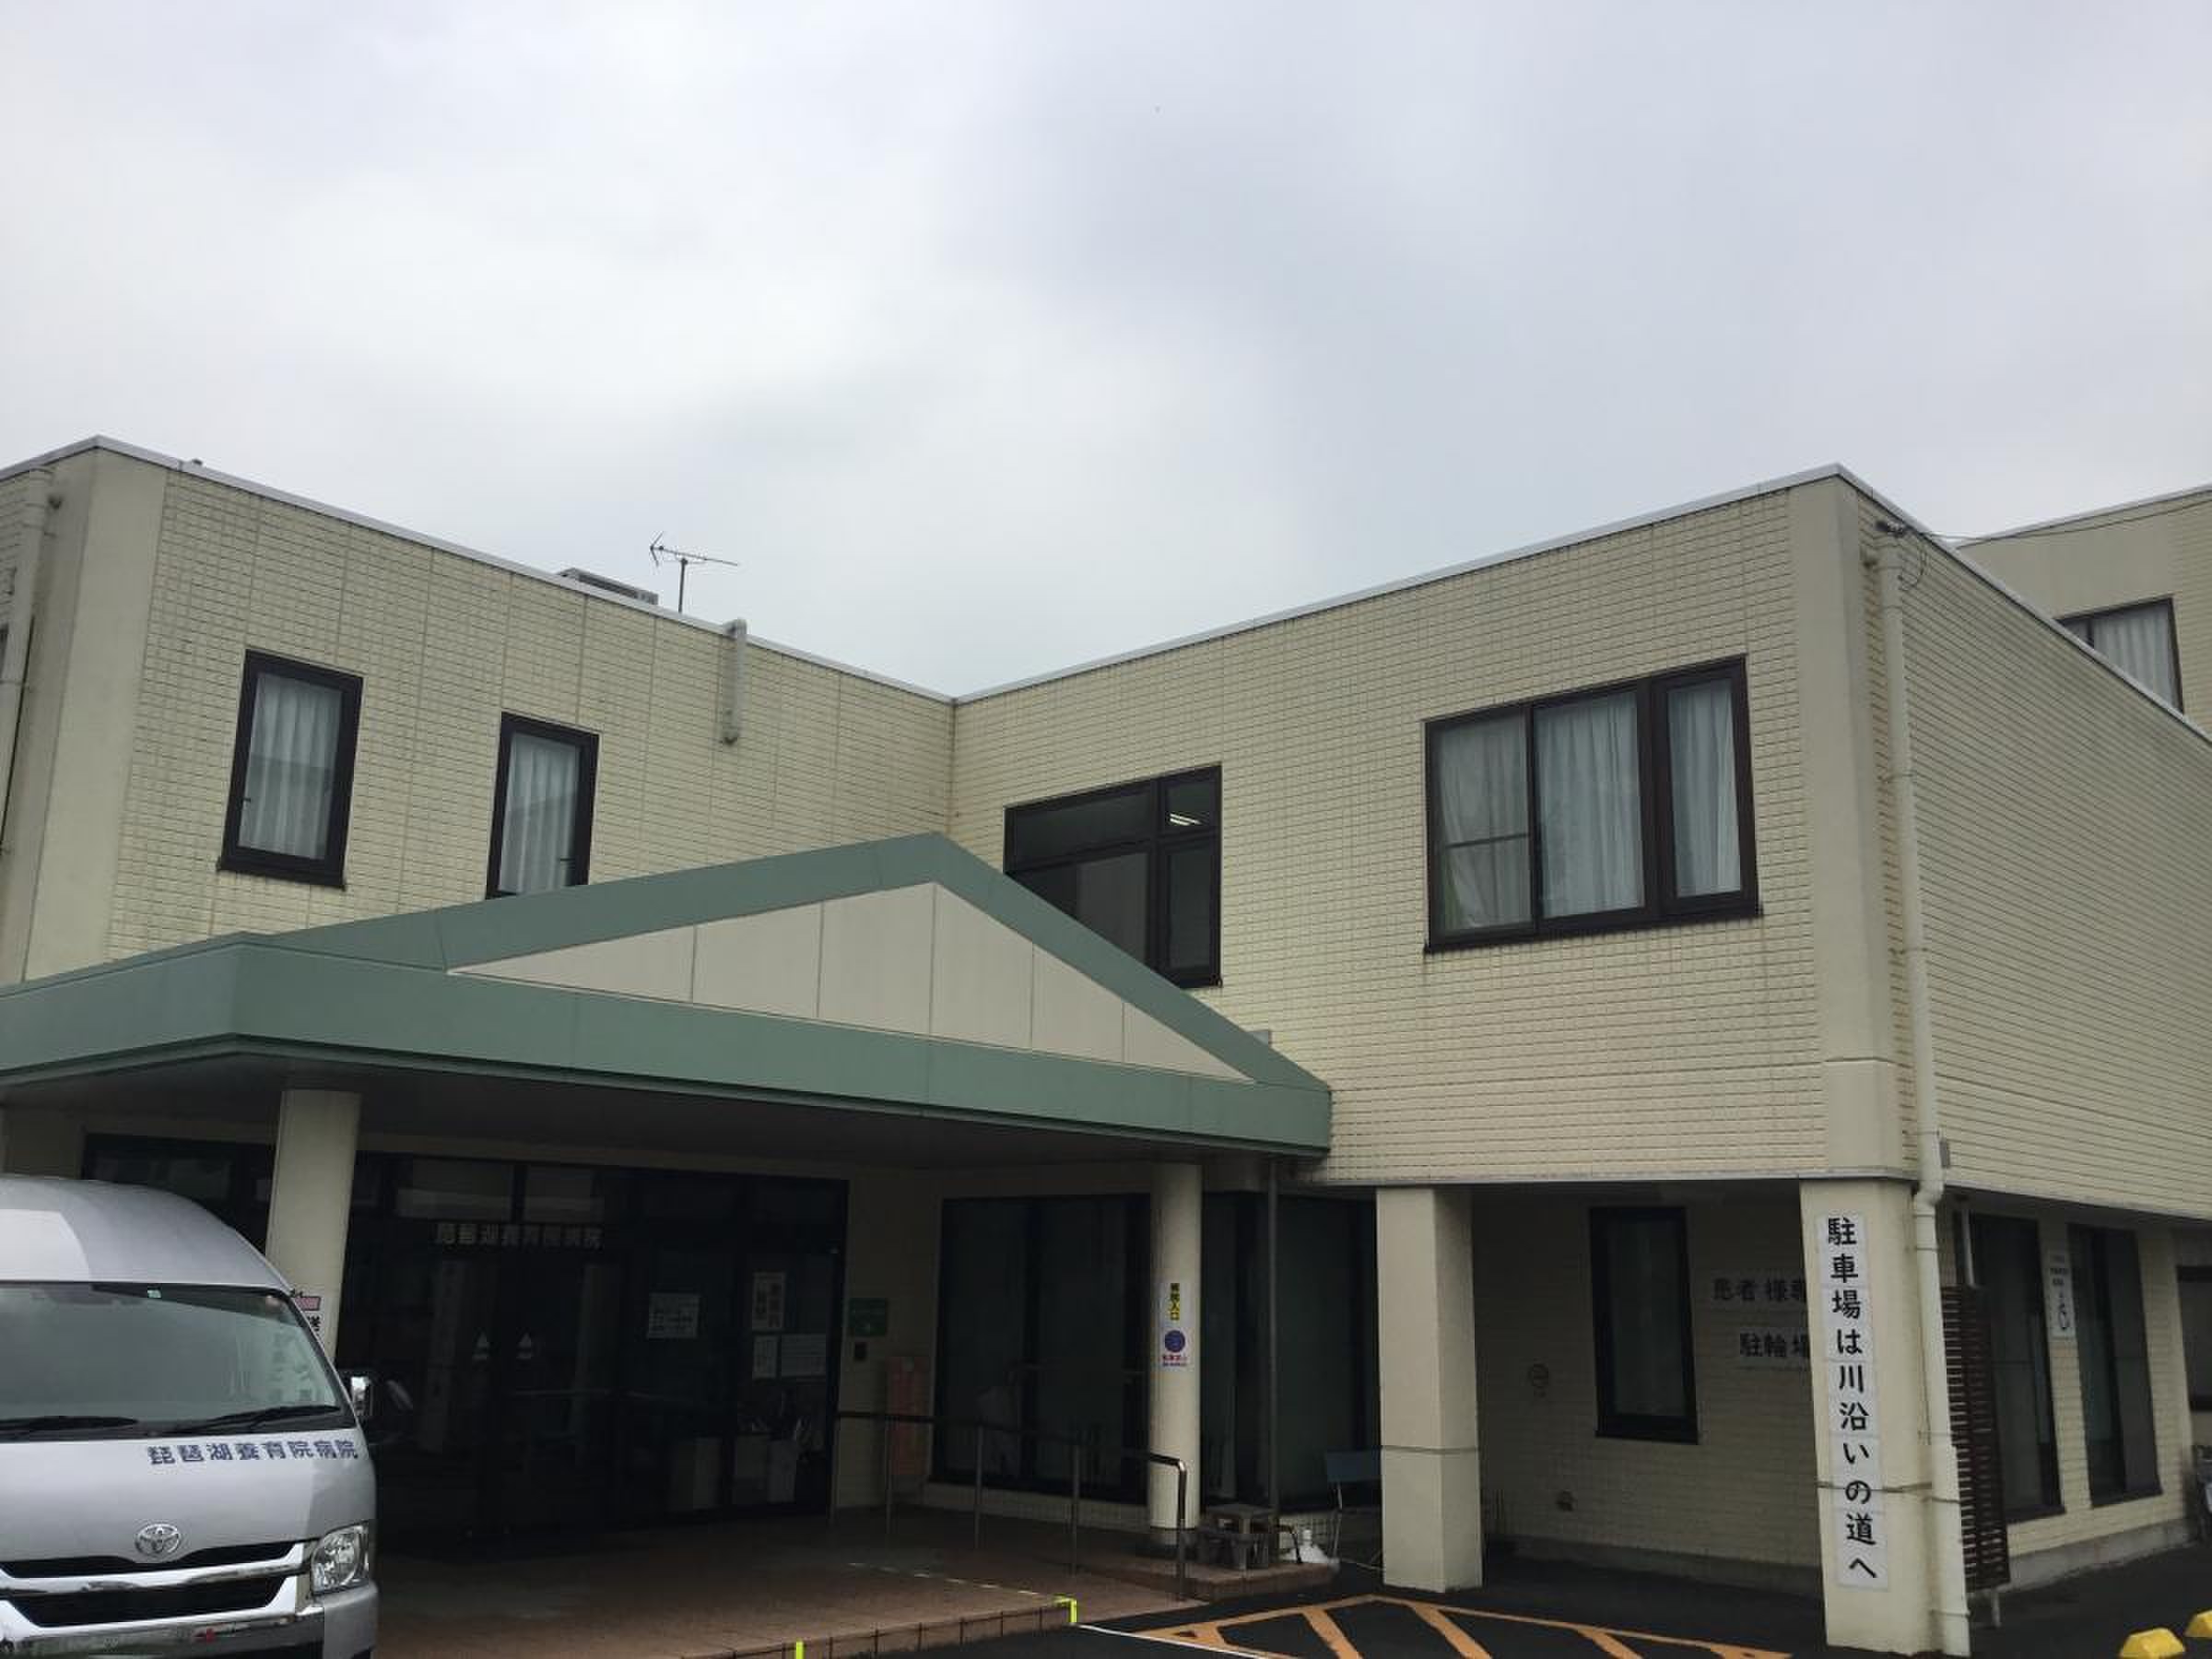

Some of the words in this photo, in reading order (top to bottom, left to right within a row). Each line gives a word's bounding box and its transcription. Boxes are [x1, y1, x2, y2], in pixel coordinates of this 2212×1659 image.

[147, 1438, 359, 1465] 琵琶湖養育院病院
[1827, 1217, 1877, 1579] 駐車場は川沿いの道へ
